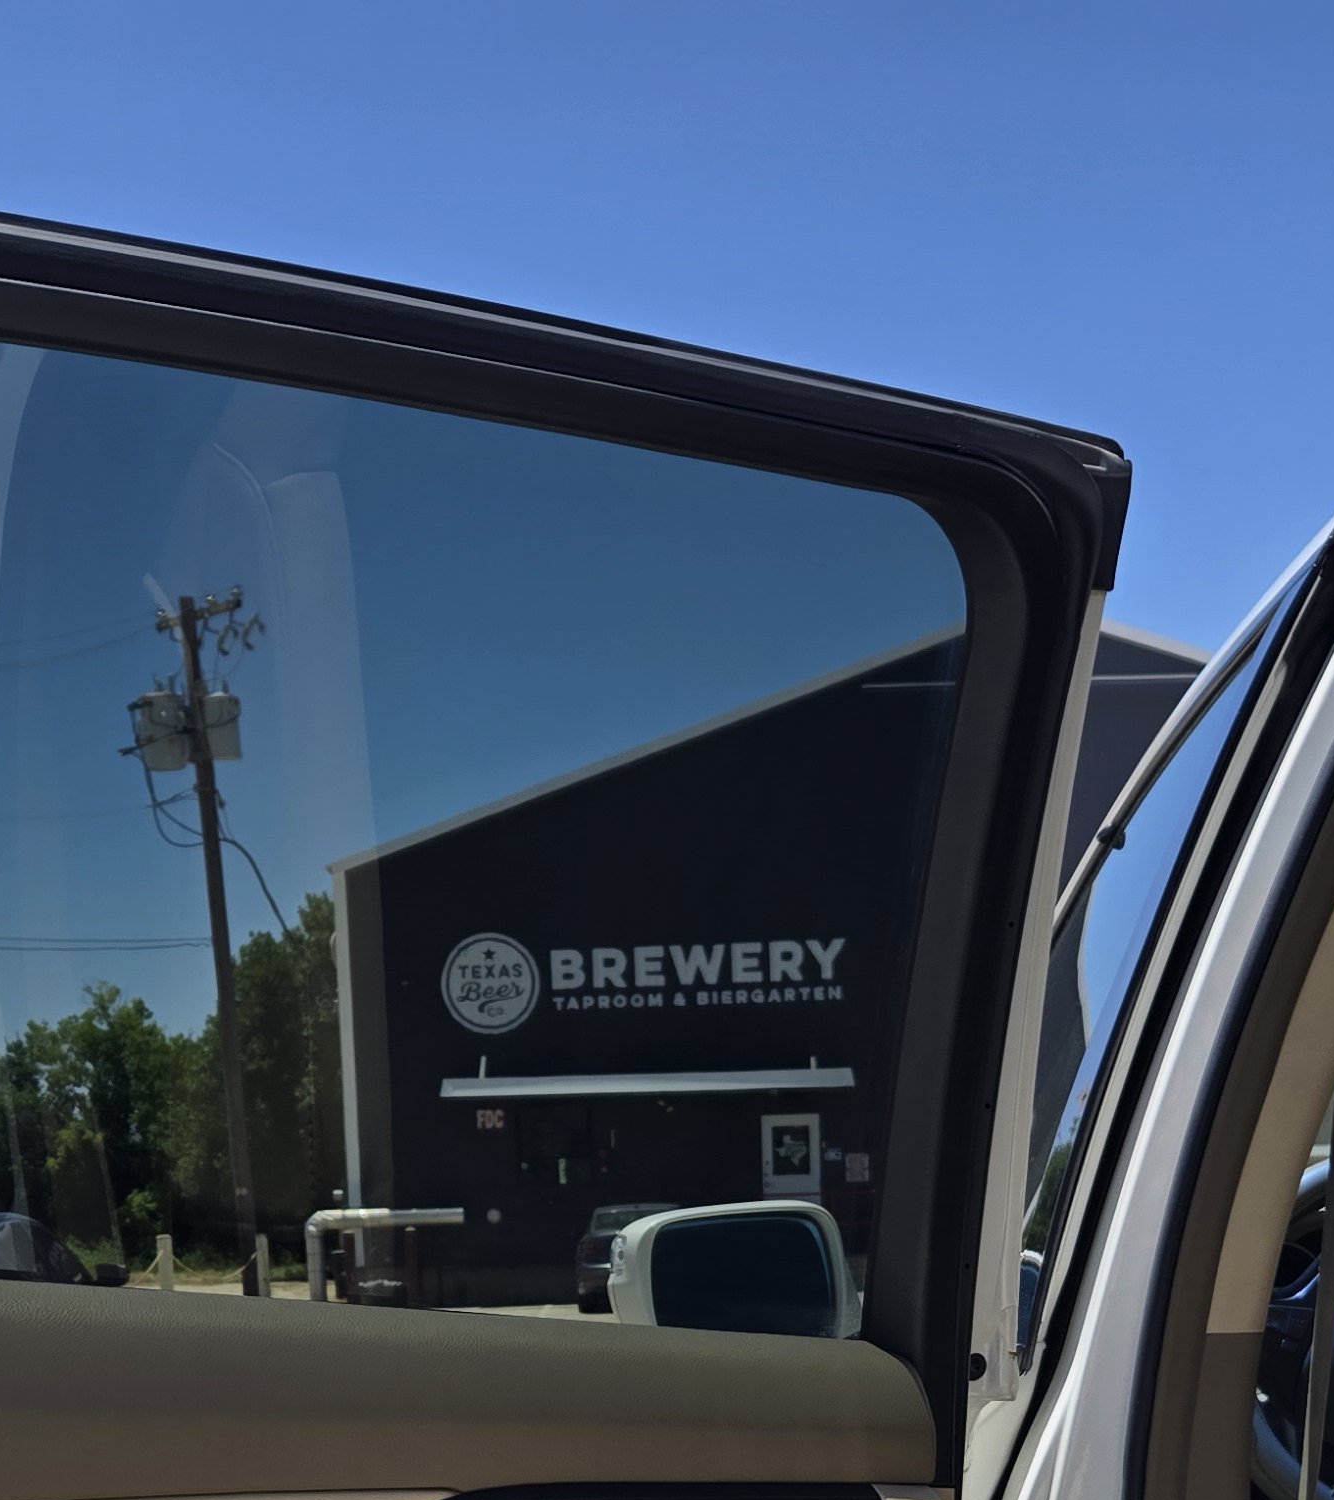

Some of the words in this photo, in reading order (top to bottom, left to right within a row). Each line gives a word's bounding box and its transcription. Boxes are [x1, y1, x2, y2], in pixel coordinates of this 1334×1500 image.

[458, 963, 523, 979] TEXAS
[550, 938, 846, 990] BREWERY
[457, 981, 525, 1003] Beer
[552, 992, 664, 1011] TAPROOM
[673, 992, 686, 1006] &
[696, 985, 843, 1006] BIERGARTEN
[476, 1108, 505, 1129] FDC
